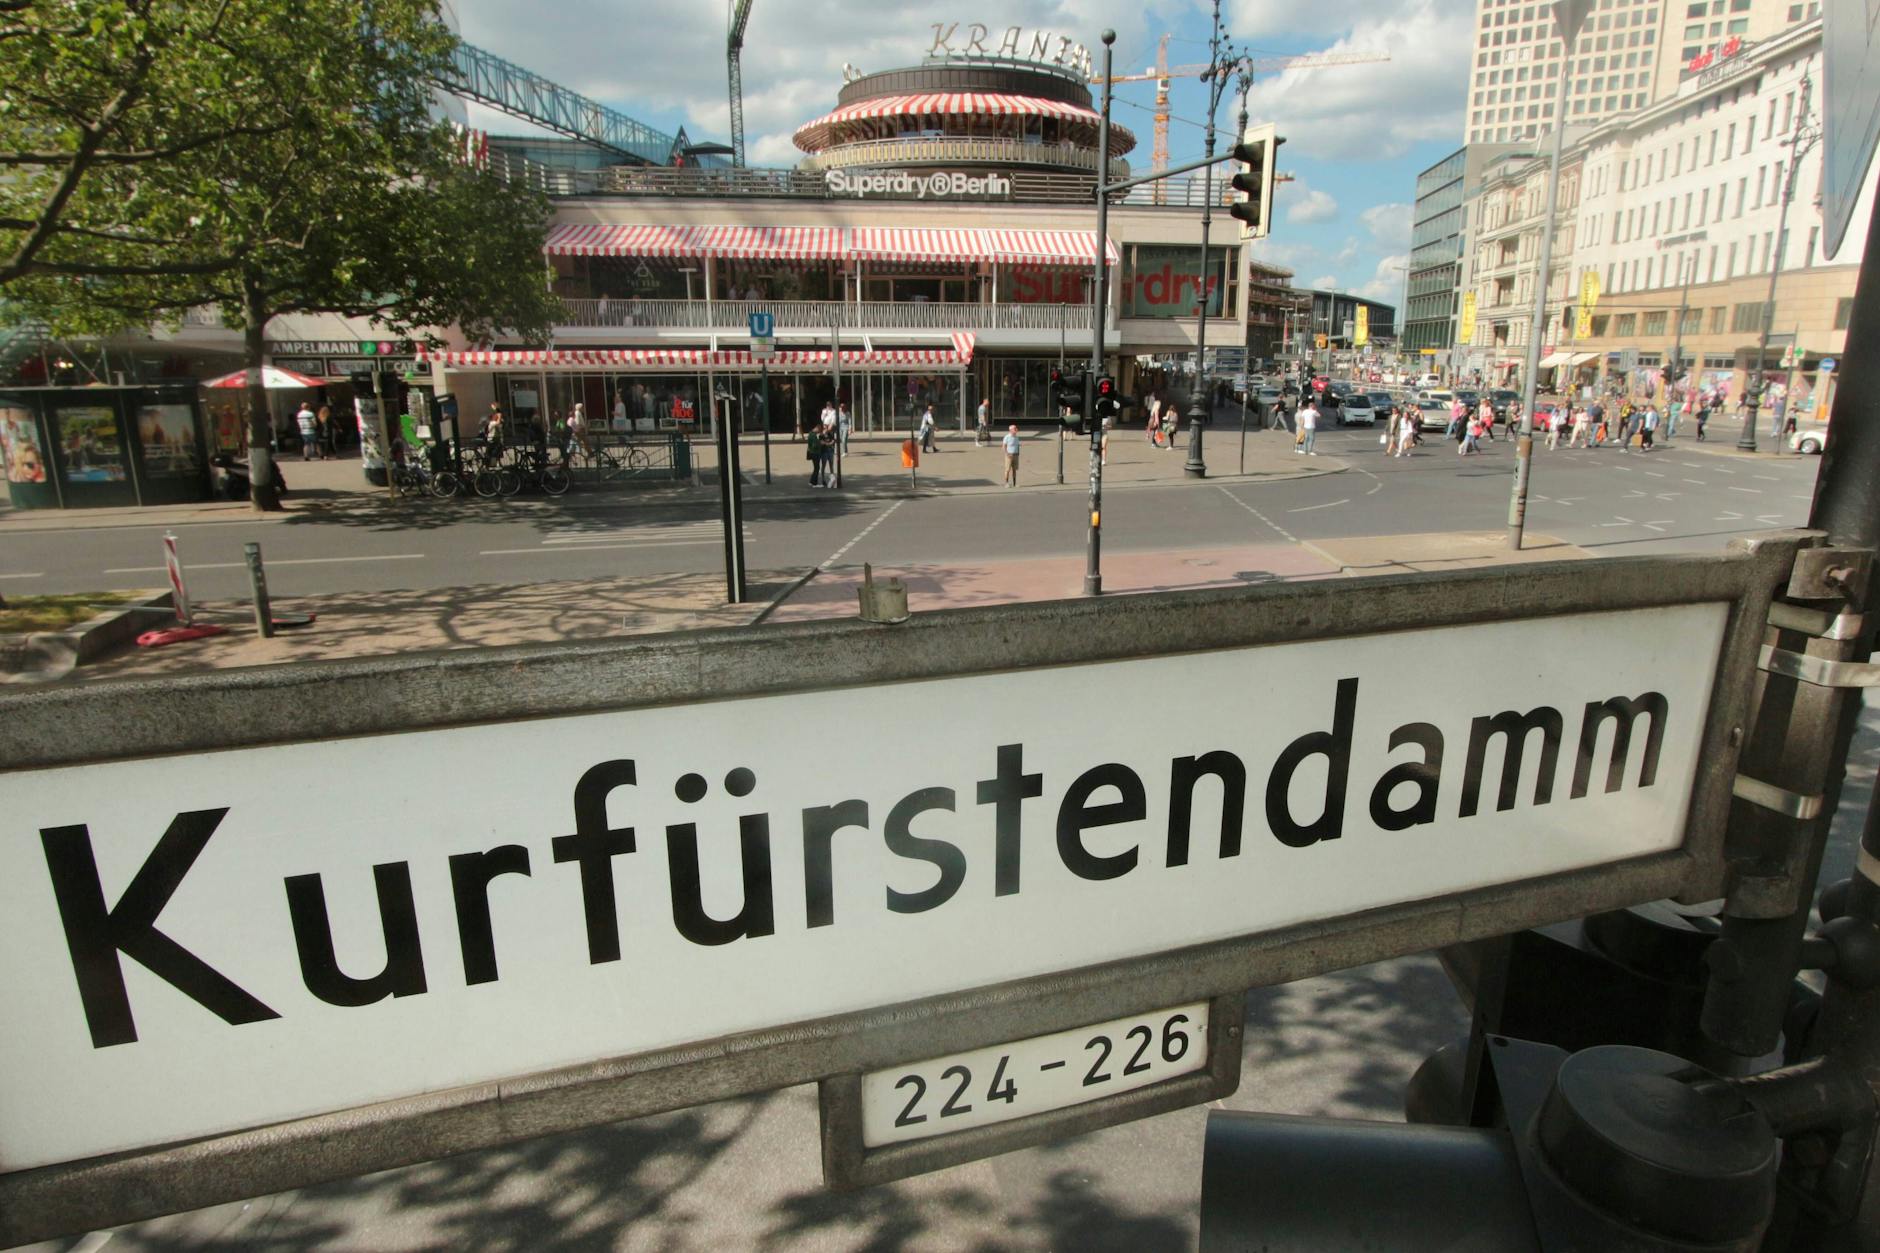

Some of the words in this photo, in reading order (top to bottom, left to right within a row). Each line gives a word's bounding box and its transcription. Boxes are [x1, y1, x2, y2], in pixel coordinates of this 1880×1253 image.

[753, 315, 769, 335] U
[272, 342, 360, 354] AMPELMANN
[39, 677, 1669, 1050] Kurfürstendamm
